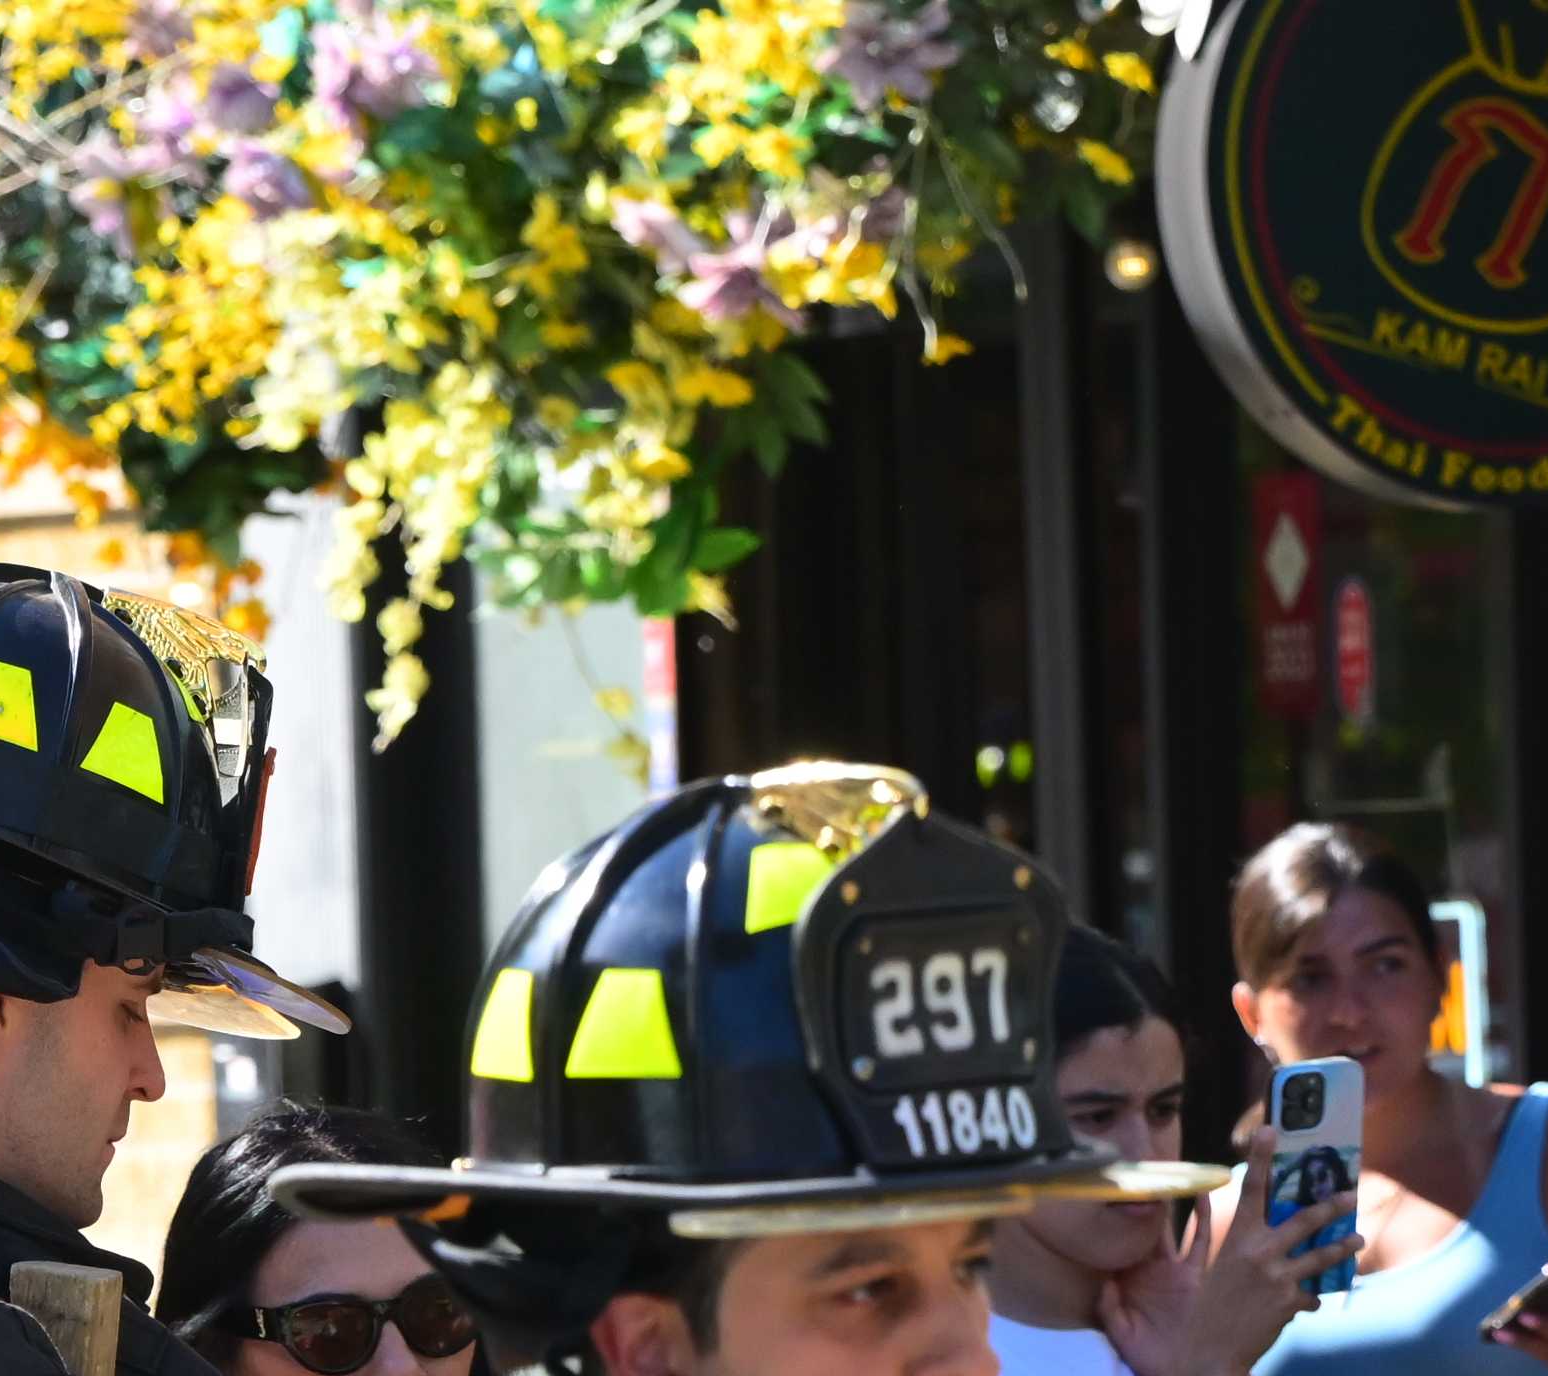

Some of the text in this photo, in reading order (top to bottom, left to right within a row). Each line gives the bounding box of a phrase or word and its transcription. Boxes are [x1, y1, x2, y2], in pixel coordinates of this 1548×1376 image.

[1371, 308, 1469, 371] KAM
[1329, 392, 1428, 477] Thai
[871, 948, 1010, 1058] 297
[893, 1084, 1037, 1158] 11840
